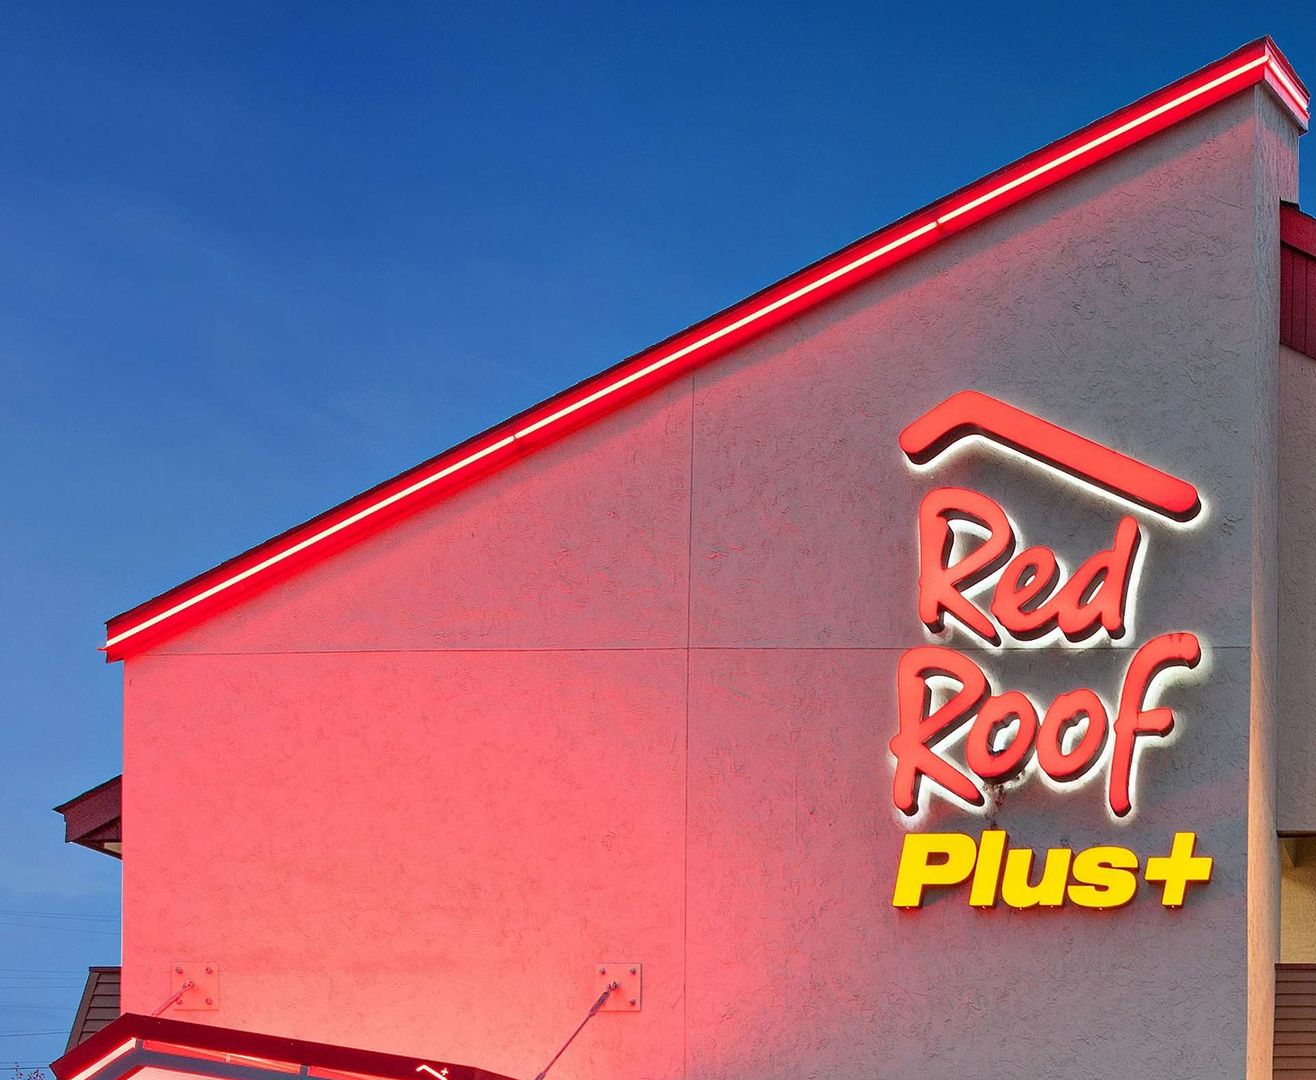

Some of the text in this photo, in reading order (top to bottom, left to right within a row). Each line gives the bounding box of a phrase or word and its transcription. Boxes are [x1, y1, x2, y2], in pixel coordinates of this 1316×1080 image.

[918, 486, 1142, 647] Red
[889, 632, 1202, 818] Roof
[892, 830, 1213, 909] Plus+
